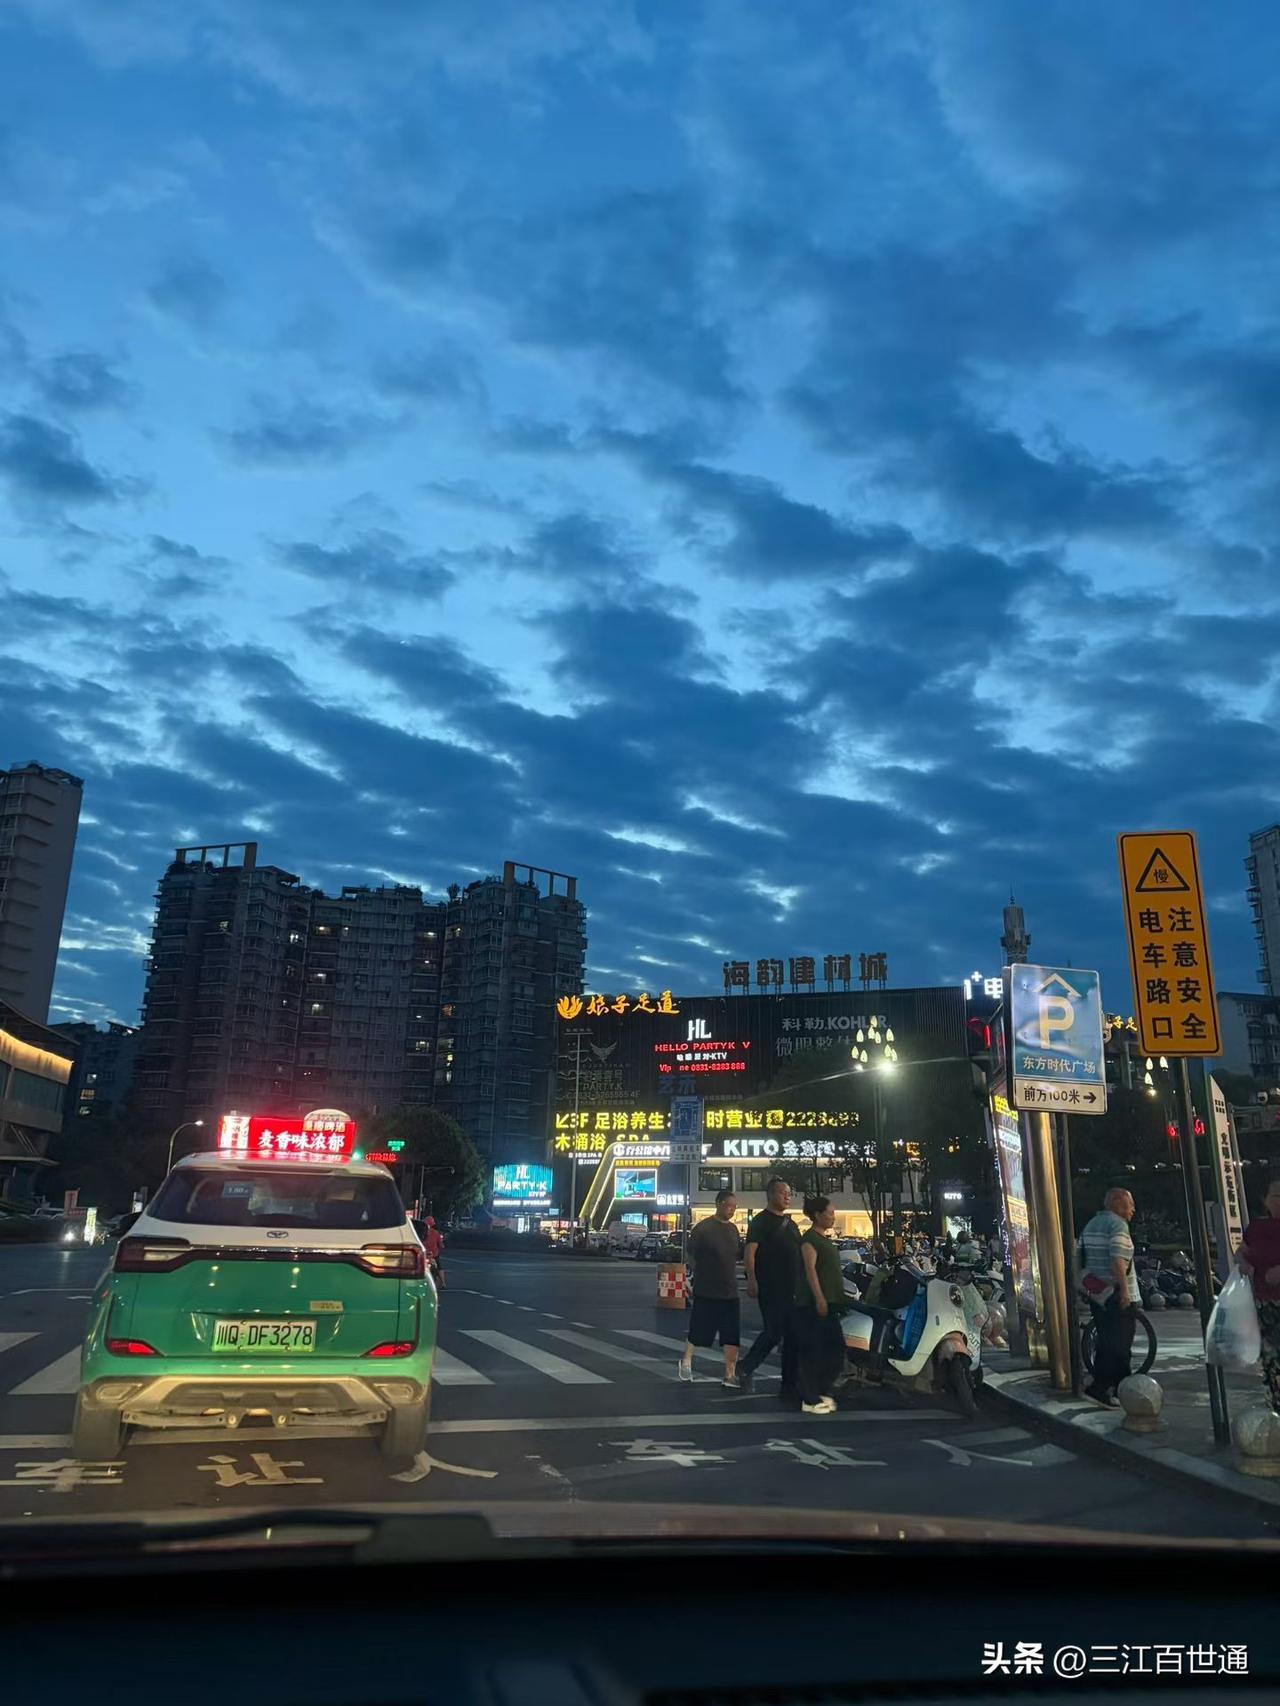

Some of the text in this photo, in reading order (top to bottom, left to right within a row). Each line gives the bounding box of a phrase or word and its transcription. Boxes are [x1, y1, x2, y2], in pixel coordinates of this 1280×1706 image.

[1153, 869, 1168, 884] 慢
[1139, 908, 1173, 1039] 电车路口
[1168, 907, 1206, 1039] 注意安全
[586, 990, 681, 1016] 娘子足道
[1039, 996, 1075, 1049] P
[654, 1043, 689, 1052] HELLO
[1022, 1055, 1096, 1074] 东方时代广场
[1024, 1086, 1080, 1104] 前方100米
[258, 1129, 345, 1152] 麦香味浓郁
[723, 1139, 779, 1156] KITO
